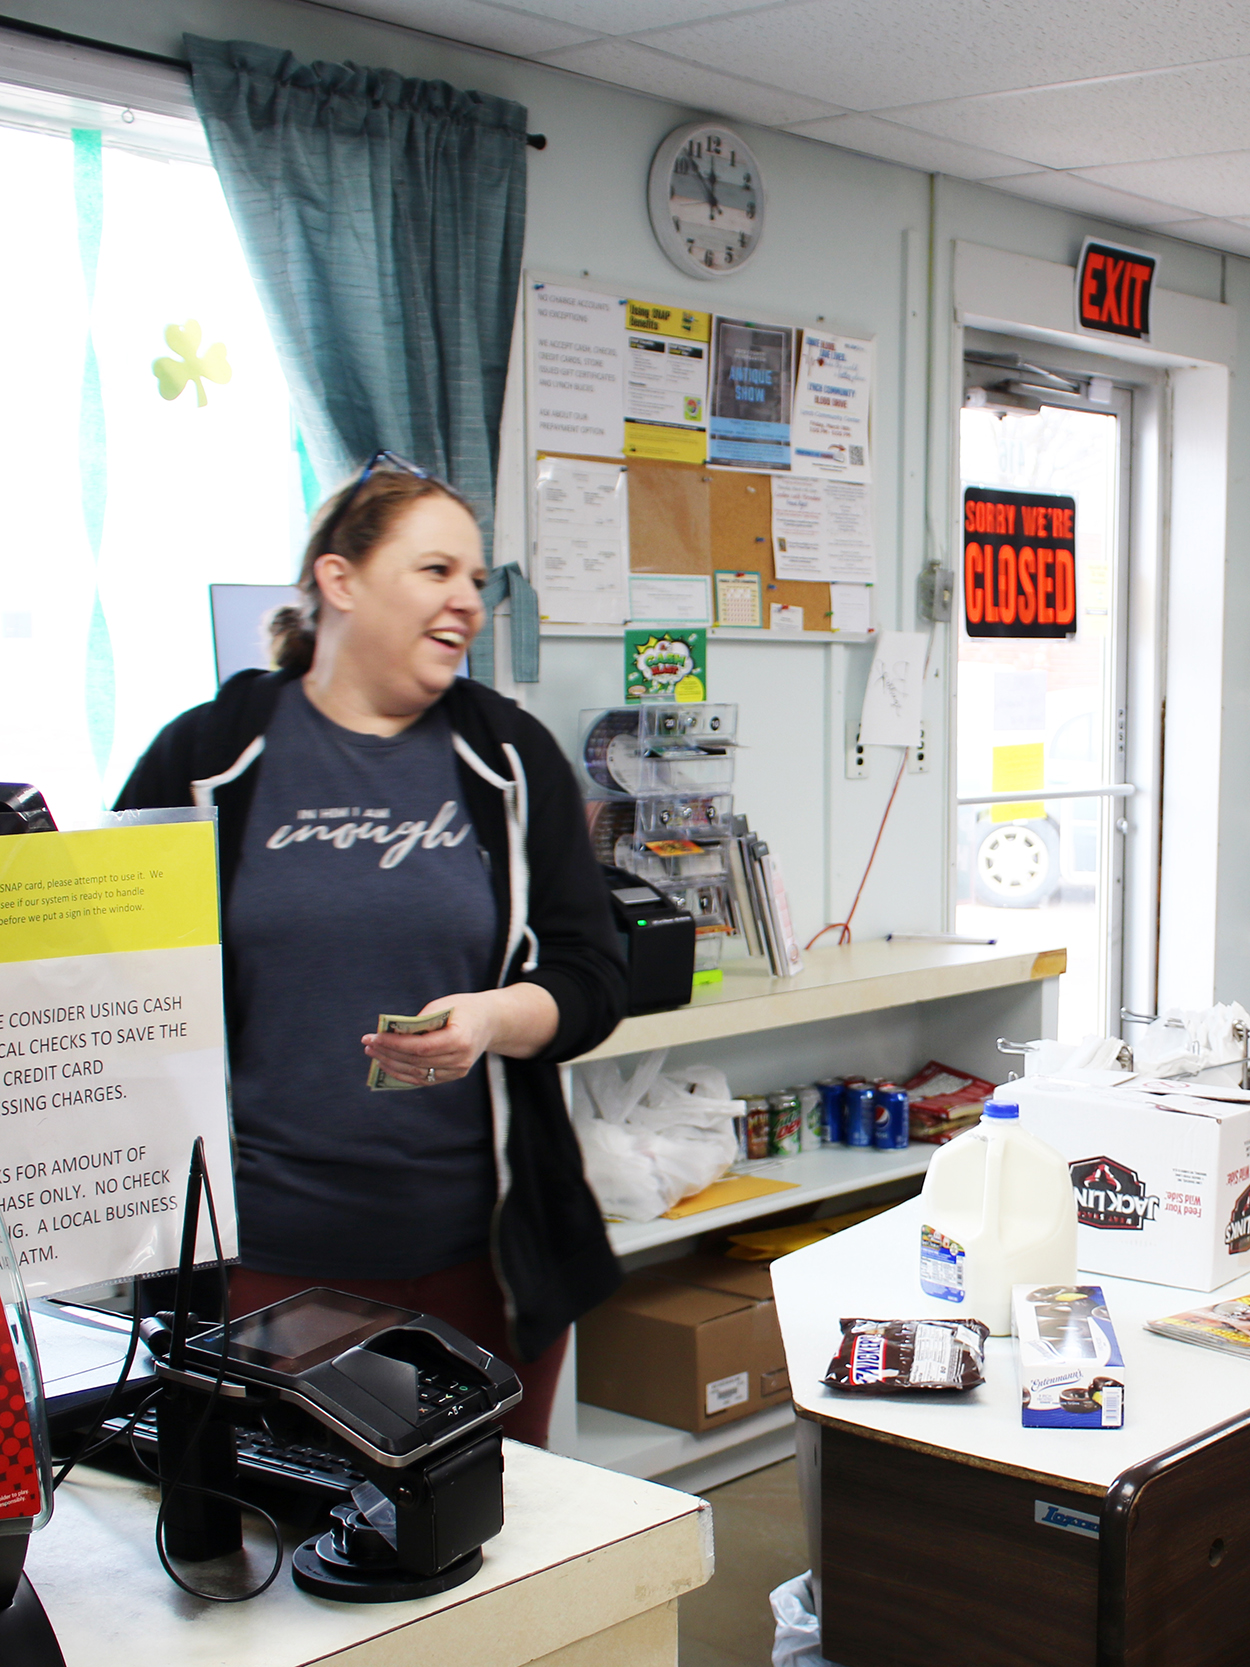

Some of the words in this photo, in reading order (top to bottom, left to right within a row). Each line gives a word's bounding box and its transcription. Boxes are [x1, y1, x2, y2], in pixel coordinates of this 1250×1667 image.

[688, 139, 702, 158] 11
[706, 135, 722, 155] 12
[729, 150, 737, 167] 1
[743, 172, 751, 190] 2
[746, 202, 756, 219] 3
[686, 237, 695, 254] 7
[738, 231, 747, 248] 4
[704, 249, 714, 267] 6
[724, 245, 734, 264] 5
[1081, 252, 1151, 330] EXIT
[537, 308, 548, 317] NO
[629, 303, 649, 319] Using
[729, 365, 773, 386] ANTIQUE
[735, 384, 766, 403] SHOW
[964, 499, 1016, 536] SORRY
[1021, 504, 1074, 540] WE'RE
[964, 540, 1076, 626] CLOSED
[711, 720, 720, 728] 10
[662, 812, 669, 822] 5
[707, 807, 715, 818] 3
[265, 800, 473, 869] enough
[0, 882, 23, 893] SNAP
[24, 880, 46, 891] card,
[46, 878, 72, 890] please
[74, 875, 107, 886] attempt
[109, 873, 119, 883] to
[120, 873, 136, 882] use
[137, 870, 146, 881] it.
[149, 869, 164, 879] We
[0, 900, 16, 910] see
[16, 898, 23, 908] if
[24, 898, 39, 907] our
[41, 894, 70, 906] system
[71, 892, 78, 902] is
[79, 890, 103, 902] ready
[104, 889, 115, 899] to
[116, 886, 145, 898] handle
[28, 912, 41, 922] we
[42, 911, 57, 923] put
[58, 910, 64, 919] a
[65, 907, 82, 920] sign
[83, 906, 91, 916] in
[93, 905, 107, 915] the
[108, 902, 145, 914] window.
[9, 1004, 86, 1029] CONSIDER
[90, 999, 139, 1019] USING
[143, 995, 183, 1014] CASH
[29, 1033, 87, 1055] CHECKS
[91, 1030, 112, 1047] TO
[117, 1025, 155, 1044] SAVE
[159, 1022, 188, 1038] THE
[3, 1065, 58, 1087] CREDIT
[61, 1059, 104, 1079] CARD
[51, 1084, 128, 1109] CHARGES.
[16, 1162, 48, 1182] FOR
[51, 1149, 123, 1176] AMOUNT
[126, 1145, 147, 1163] OF
[39, 1184, 87, 1205] ONLY.
[95, 1178, 119, 1196] NO
[122, 1169, 172, 1191] CHECK
[1106, 1189, 1161, 1222] JACK
[1165, 1202, 1183, 1214] Your
[1185, 1194, 1202, 1206] Wild
[37, 1218, 48, 1235] A
[52, 1209, 102, 1231] LOCAL
[106, 1195, 179, 1222] BUSINESS
[1183, 1205, 1203, 1218] Feed
[18, 1245, 59, 1267] ATM.
[1030, 1368, 1084, 1393] Entenmann's
